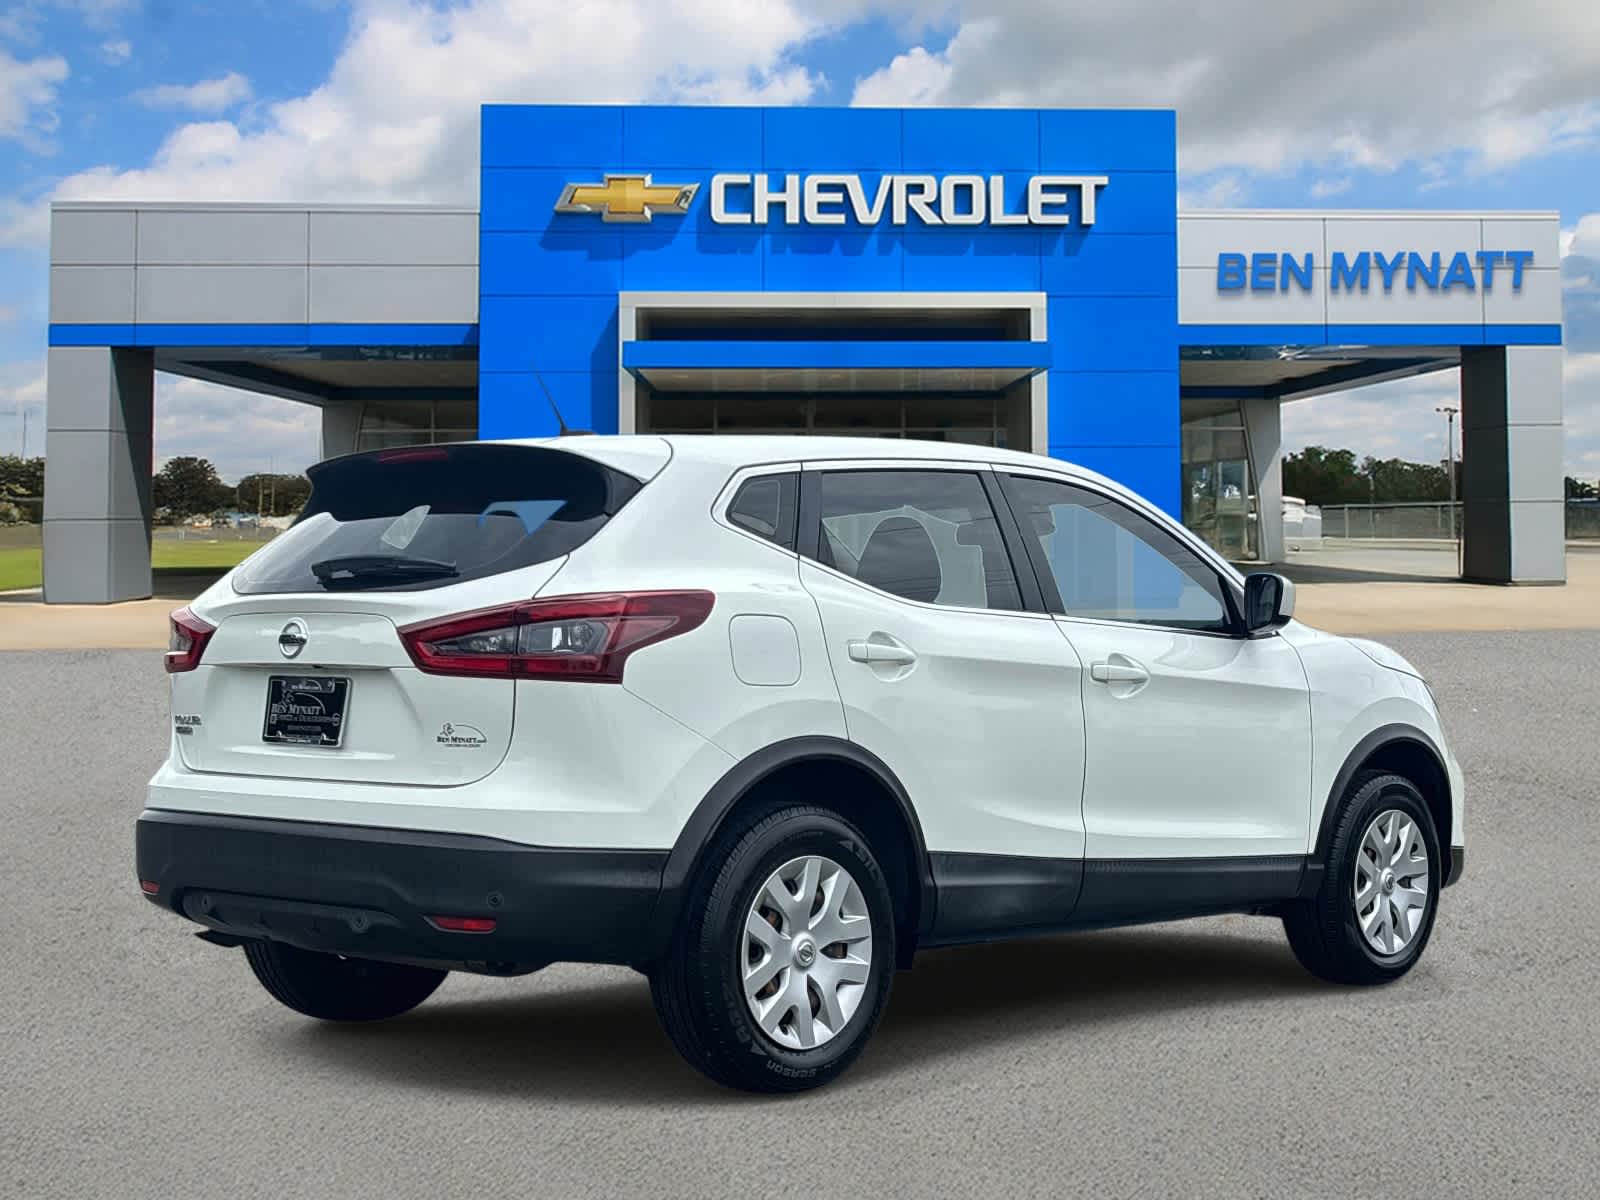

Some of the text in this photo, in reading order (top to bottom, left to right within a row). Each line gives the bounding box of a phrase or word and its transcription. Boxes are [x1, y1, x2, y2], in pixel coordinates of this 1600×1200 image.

[710, 173, 1109, 226] CHEVROLET
[1217, 250, 1534, 290] BEN MYNATT
